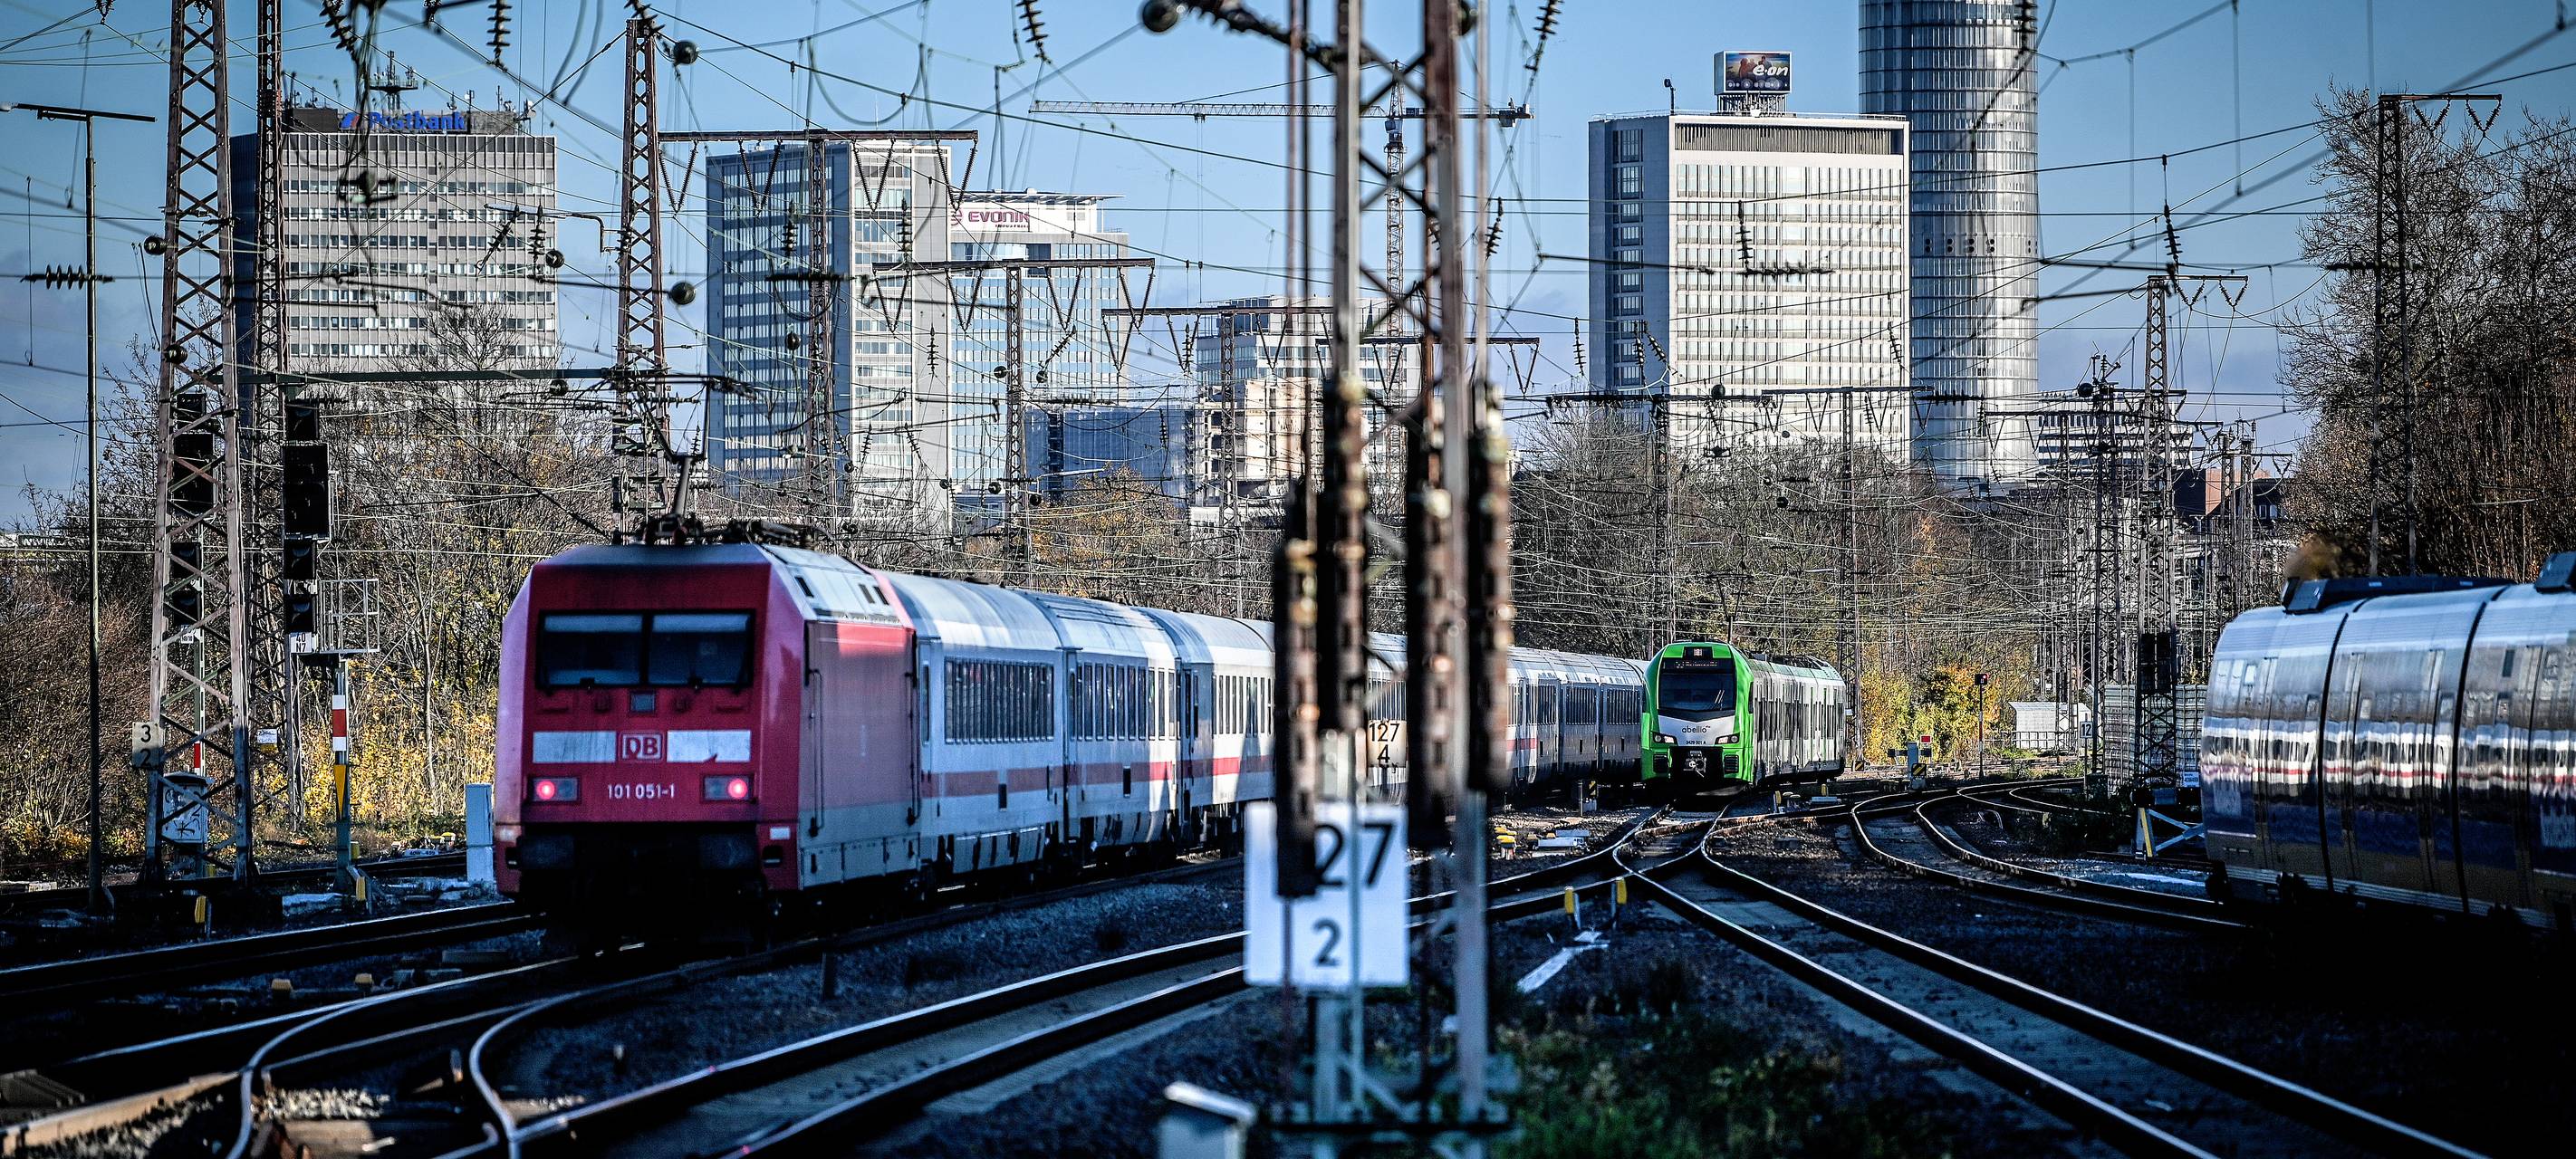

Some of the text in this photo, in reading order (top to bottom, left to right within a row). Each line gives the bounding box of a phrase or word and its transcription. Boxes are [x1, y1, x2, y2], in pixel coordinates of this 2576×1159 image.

[368, 110, 466, 130] Postbank
[295, 642, 306, 653] N7
[140, 724, 151, 742] 3
[1369, 723, 1400, 742] 127
[2081, 723, 2092, 736] 12
[625, 736, 659, 759] DB
[1377, 744, 1390, 763] 4
[139, 748, 151, 767] 2
[607, 783, 676, 800] 101 051-1
[1312, 822, 1395, 887] 27
[1312, 917, 1341, 968] 2
